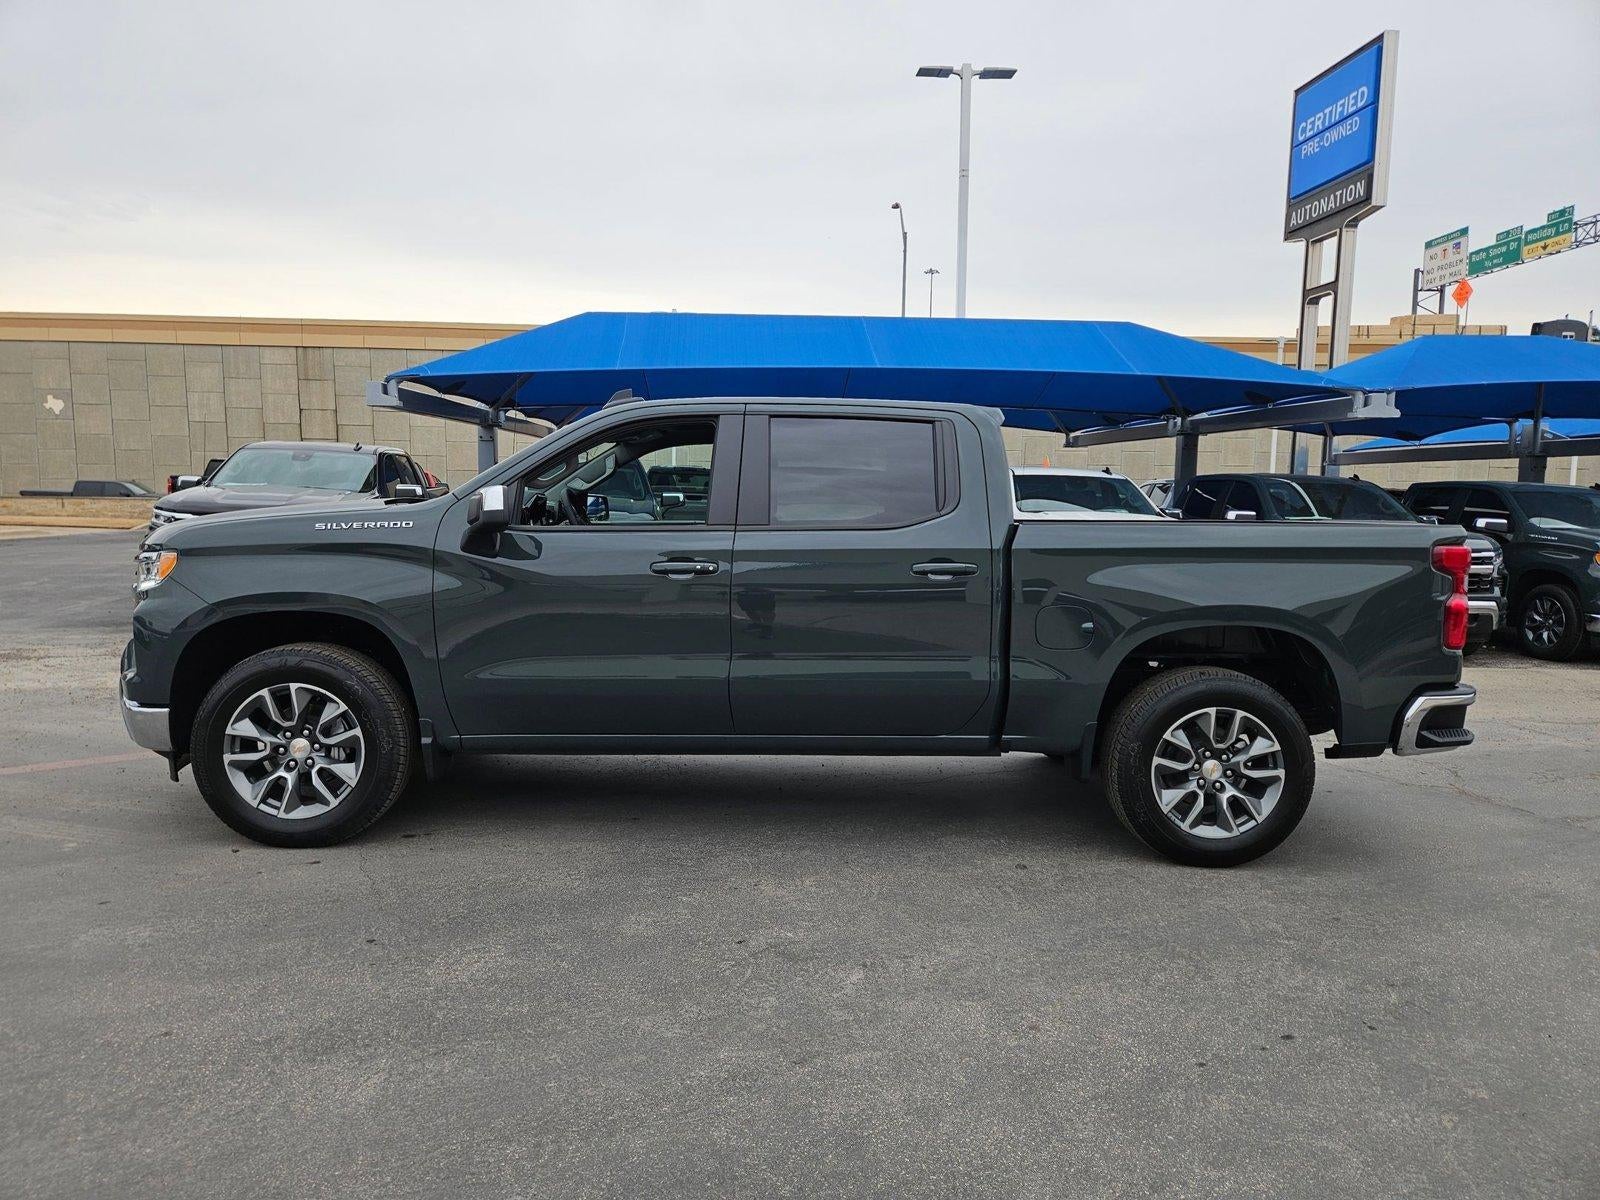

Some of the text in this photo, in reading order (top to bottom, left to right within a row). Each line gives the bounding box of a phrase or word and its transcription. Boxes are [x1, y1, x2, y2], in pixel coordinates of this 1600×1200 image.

[1298, 86, 1368, 141] CERTIFIED
[1301, 116, 1360, 159] PRE-OWNED
[1290, 179, 1365, 227] AUTONATION
[1527, 223, 1569, 242] Holiday Ln
[1471, 252, 1486, 263] Rufe
[1489, 245, 1507, 257] Snow
[1509, 241, 1518, 250] Dr
[1527, 238, 1567, 255] EXIT ONLY
[1429, 253, 1438, 262] NO
[1426, 258, 1464, 277] NO PROBLEM
[1425, 269, 1462, 286] PAY BY MAIL
[314, 520, 415, 530] SILVERADO
